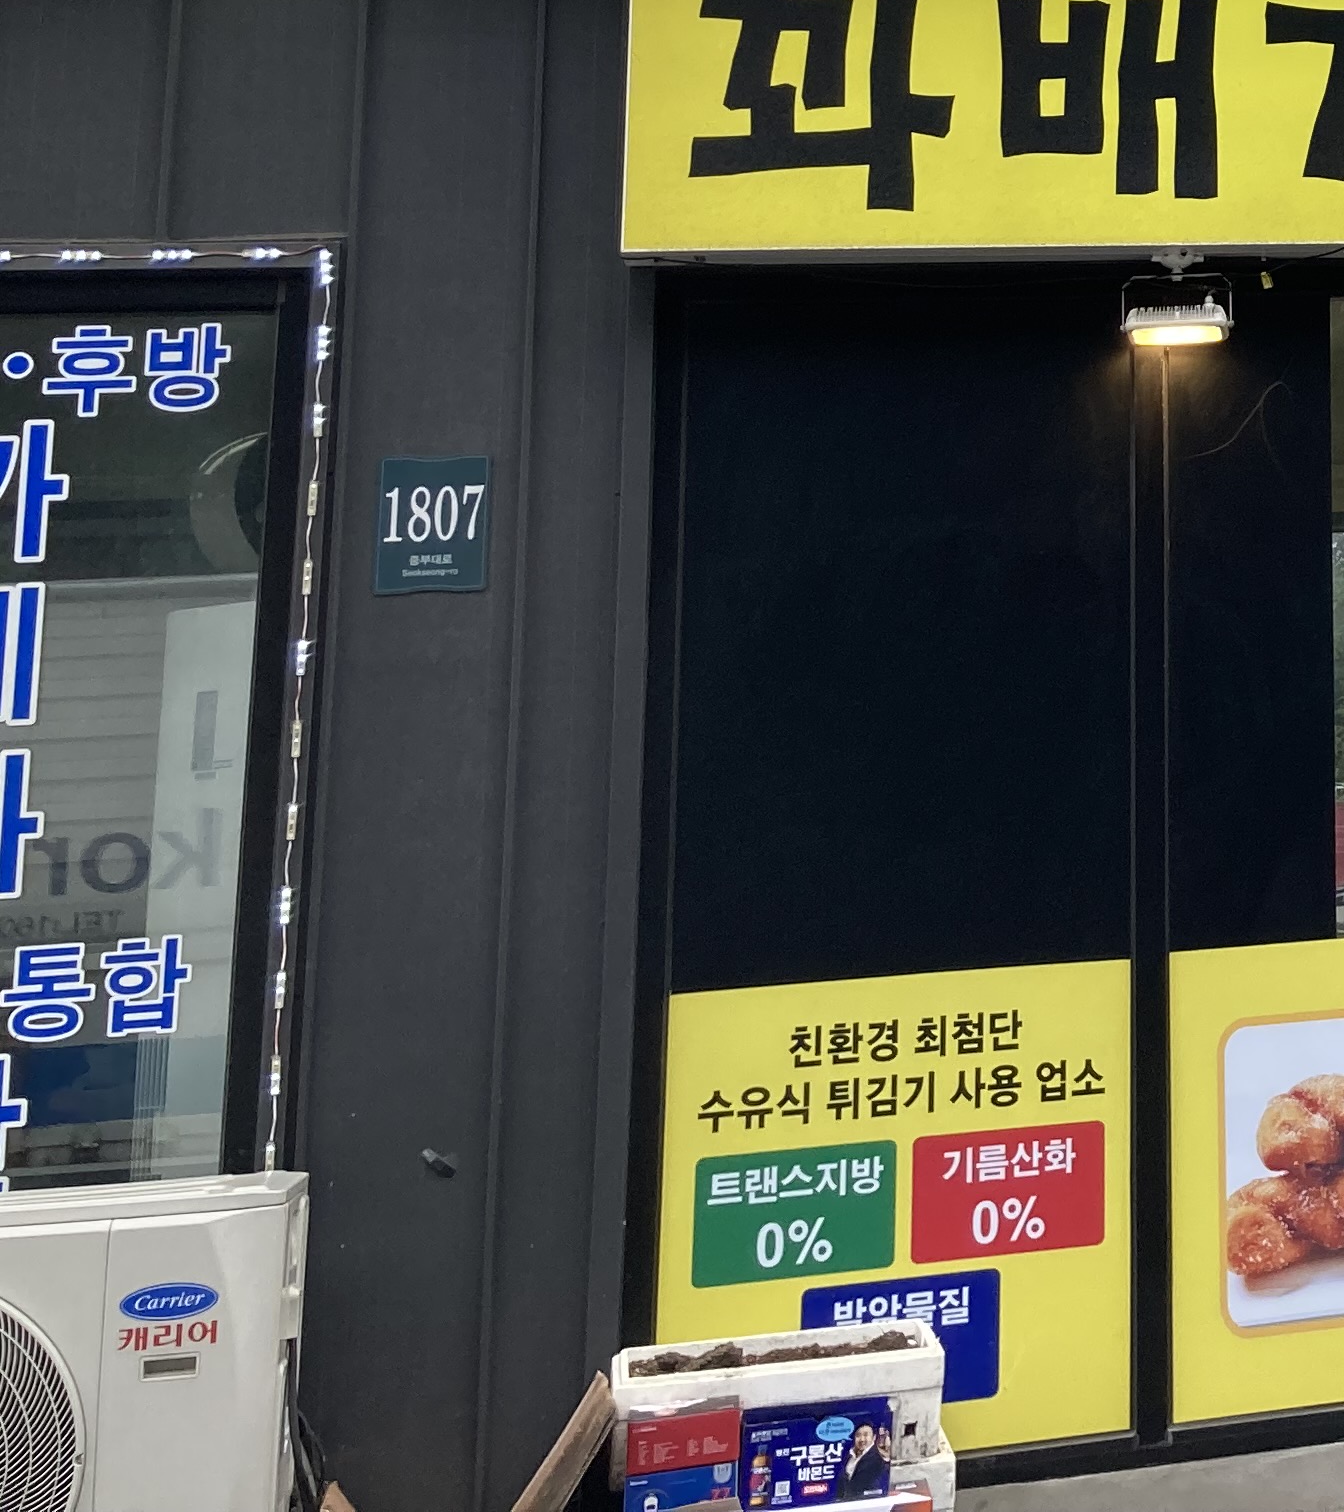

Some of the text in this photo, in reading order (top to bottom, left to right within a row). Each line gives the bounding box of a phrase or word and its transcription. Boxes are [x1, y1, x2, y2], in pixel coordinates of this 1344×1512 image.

[383, 485, 485, 543] 1807
[0, 935, 192, 1041] 통합
[788, 1009, 1023, 1068] 친환경 최첨단
[698, 1059, 1106, 1133] 수유식 튀김기 사용 업소
[707, 1155, 885, 1207] 트랜스지방
[942, 1137, 1076, 1184] 기름산화
[756, 1217, 833, 1268] 0%
[972, 1195, 1045, 1246] 0%
[134, 1290, 206, 1312] Carrier
[117, 1320, 218, 1352] 캐리어
